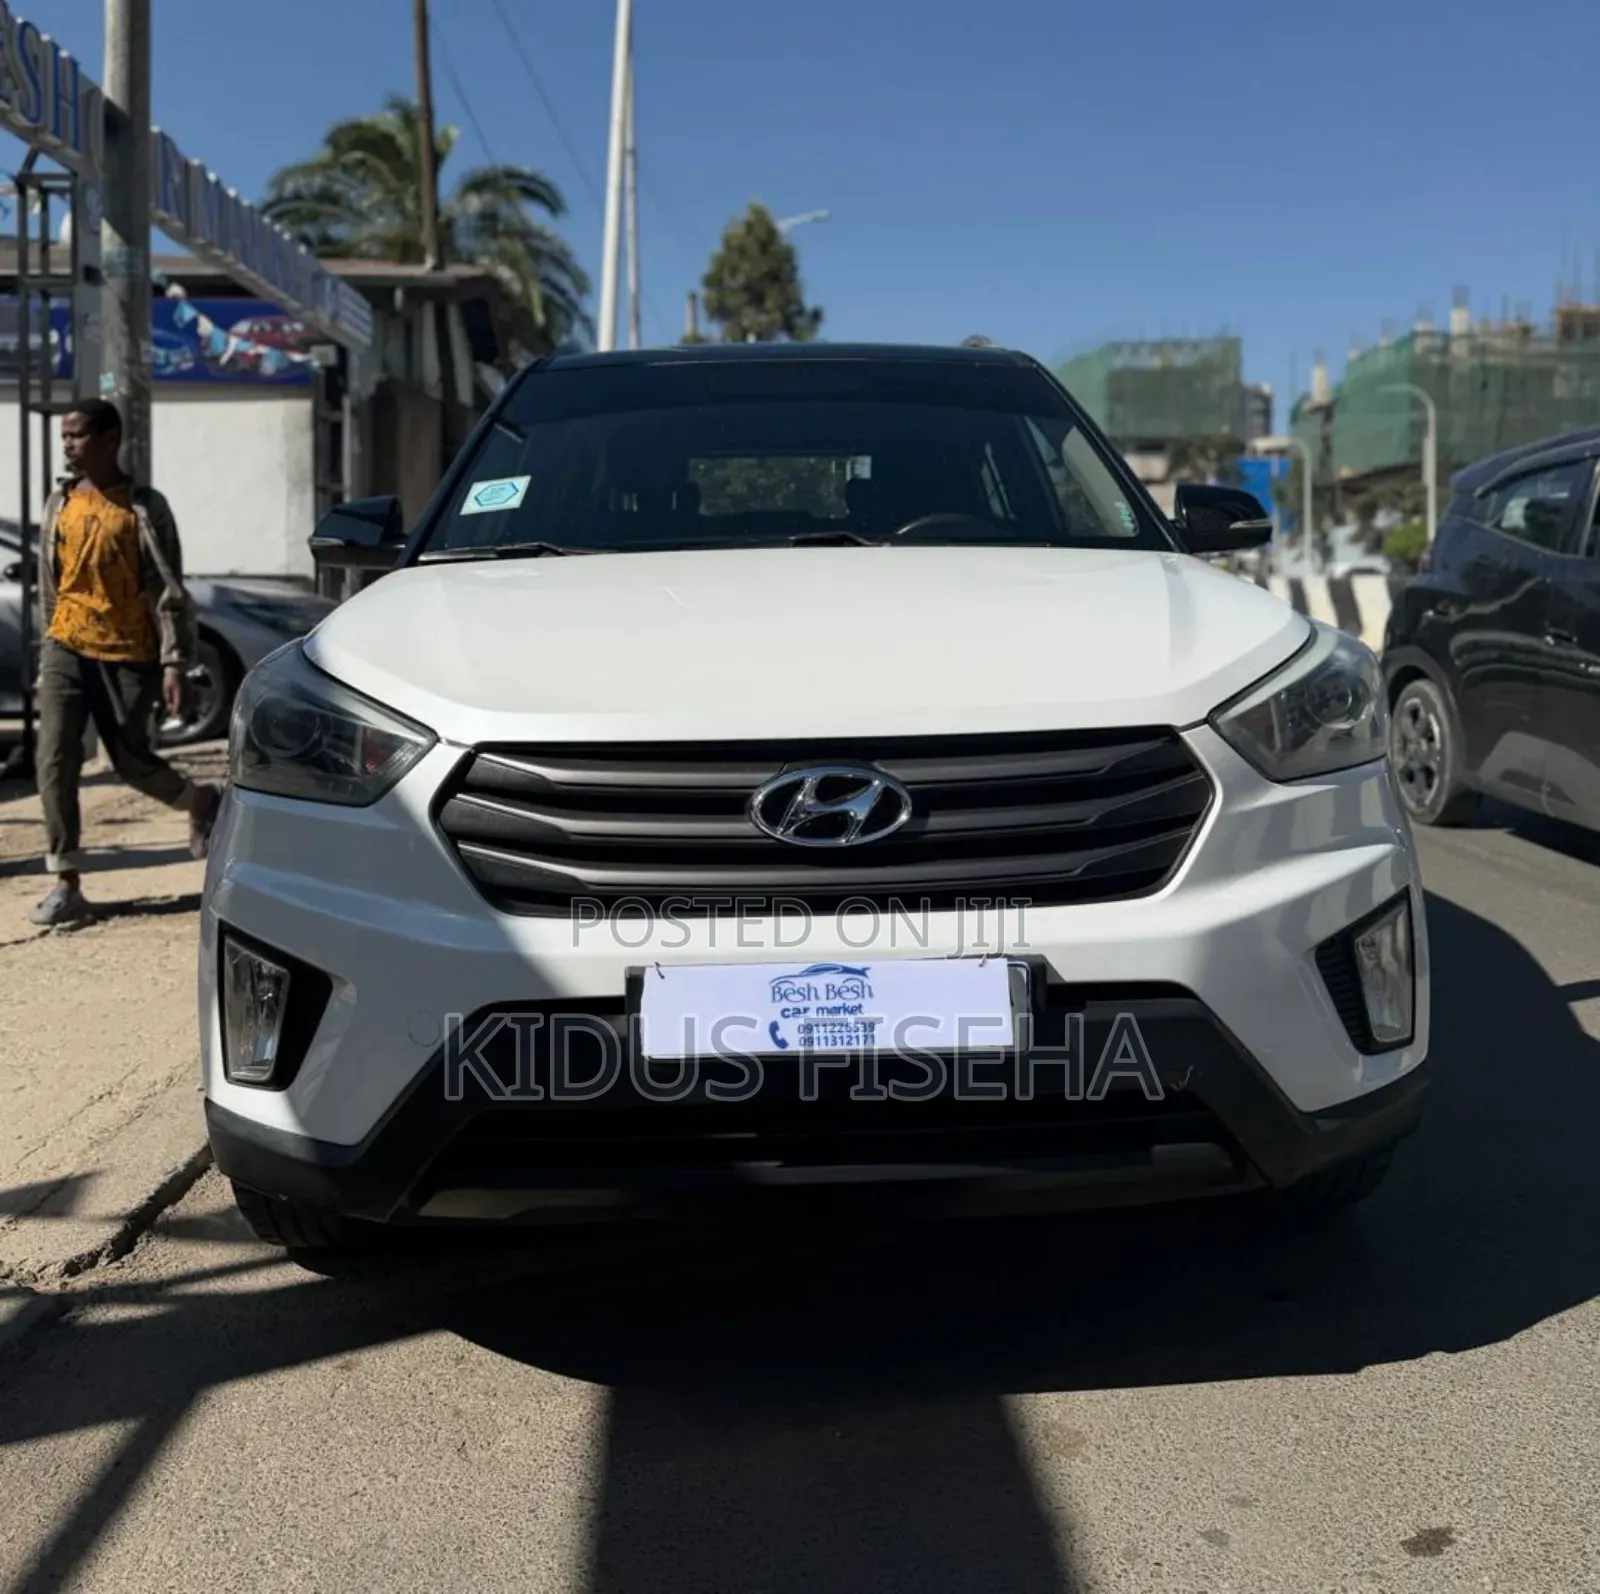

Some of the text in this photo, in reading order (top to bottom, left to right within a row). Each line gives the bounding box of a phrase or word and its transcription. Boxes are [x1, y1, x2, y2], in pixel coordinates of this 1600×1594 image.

[770, 980, 874, 1003] Besh Besh
[780, 1003, 864, 1019] car market
[798, 1033, 876, 1048] 0911312171
